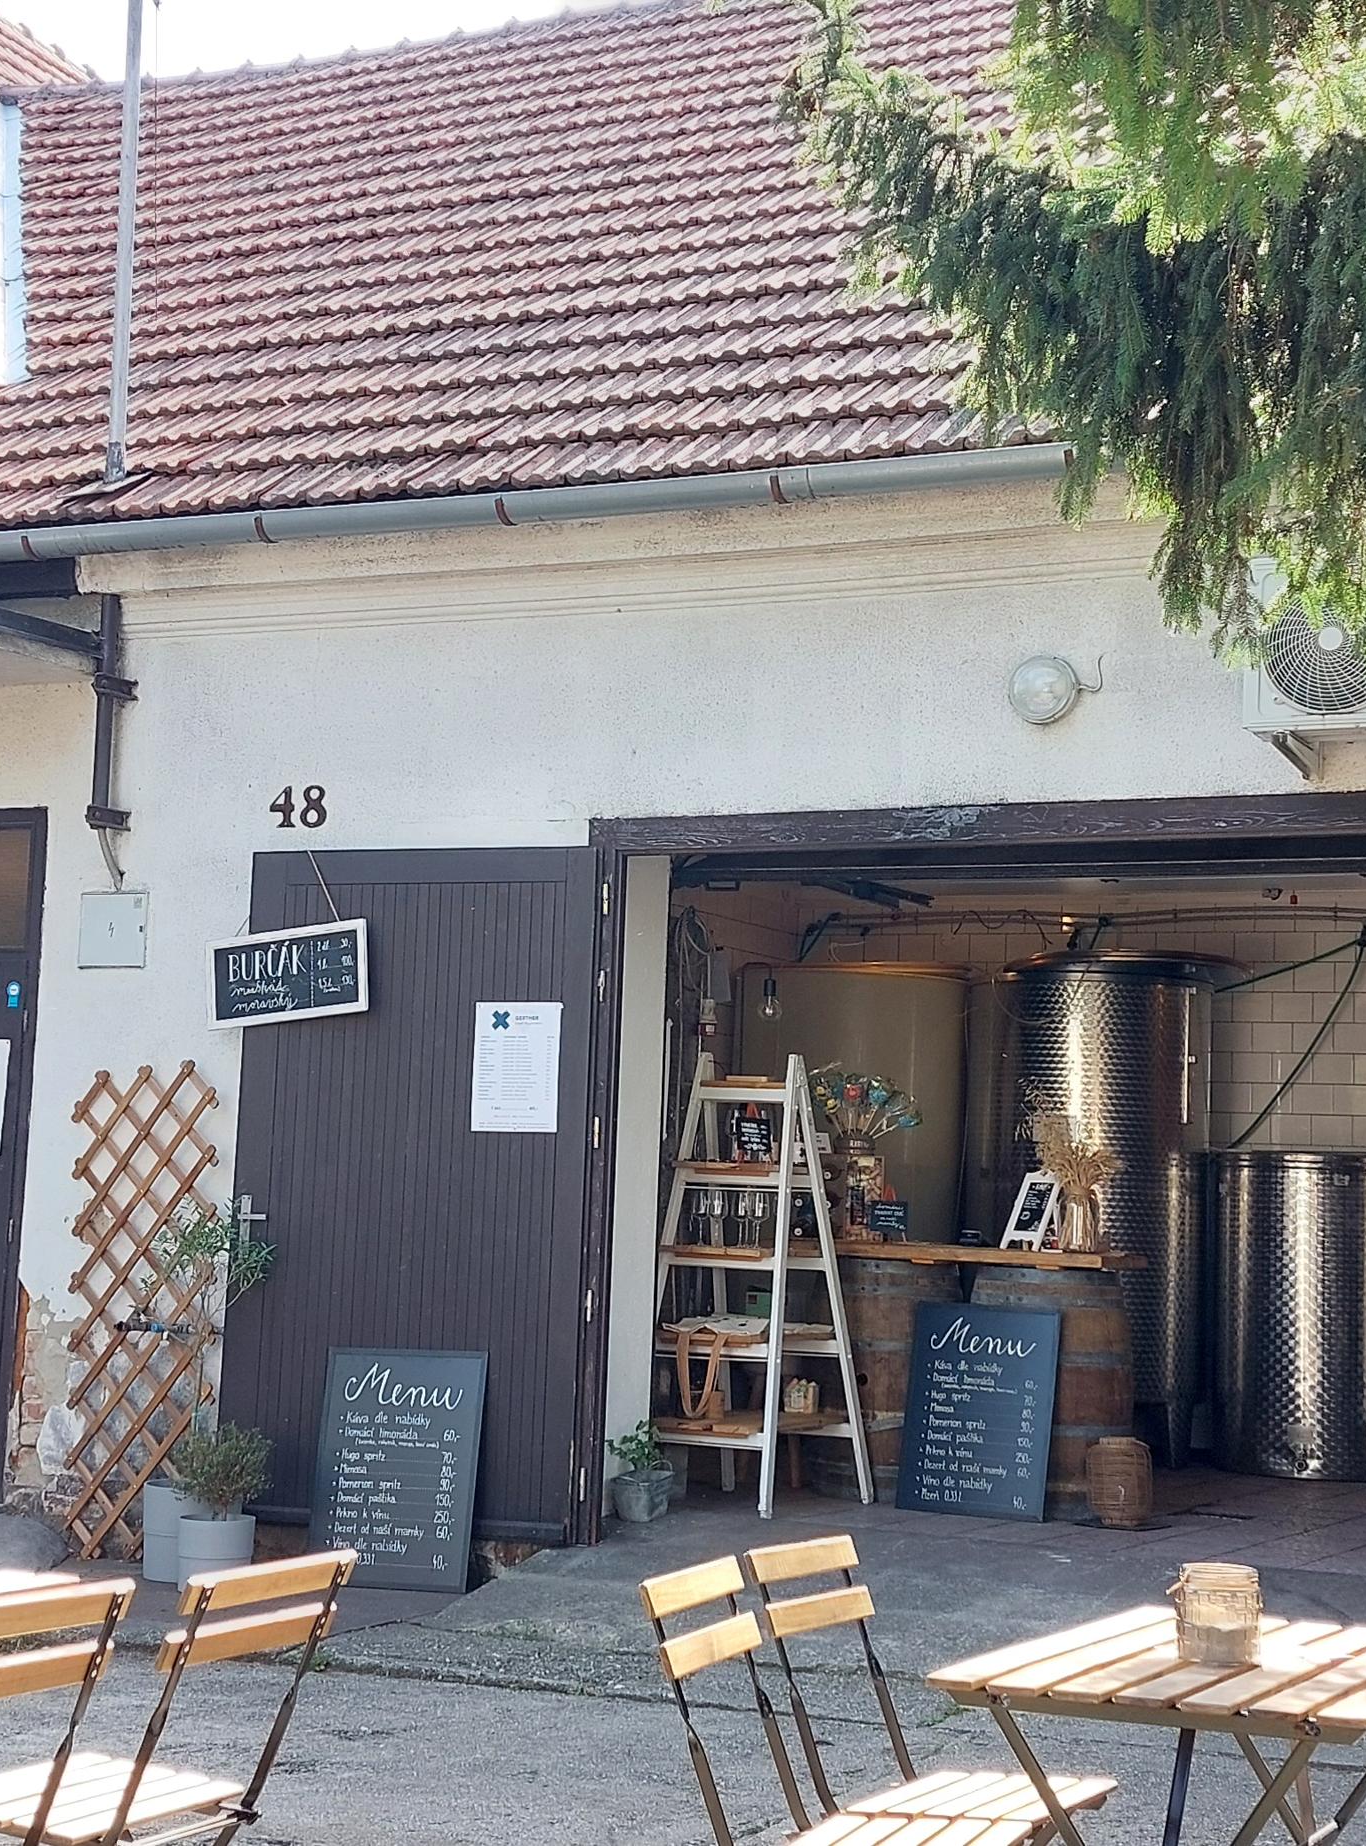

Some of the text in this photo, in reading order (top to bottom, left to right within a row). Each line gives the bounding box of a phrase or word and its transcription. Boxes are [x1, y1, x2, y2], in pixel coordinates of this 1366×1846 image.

[269, 784, 328, 829] 48
[227, 941, 307, 982] BURČÁK
[930, 1316, 1037, 1357] Menu
[344, 1362, 463, 1410] Menu
[395, 1411, 431, 1430] nabídky
[341, 1448, 360, 1462] Hugo
[339, 1462, 367, 1474] Mimosa
[949, 1460, 958, 1472] od
[360, 1523, 370, 1535] od
[355, 1537, 367, 1550] dle
